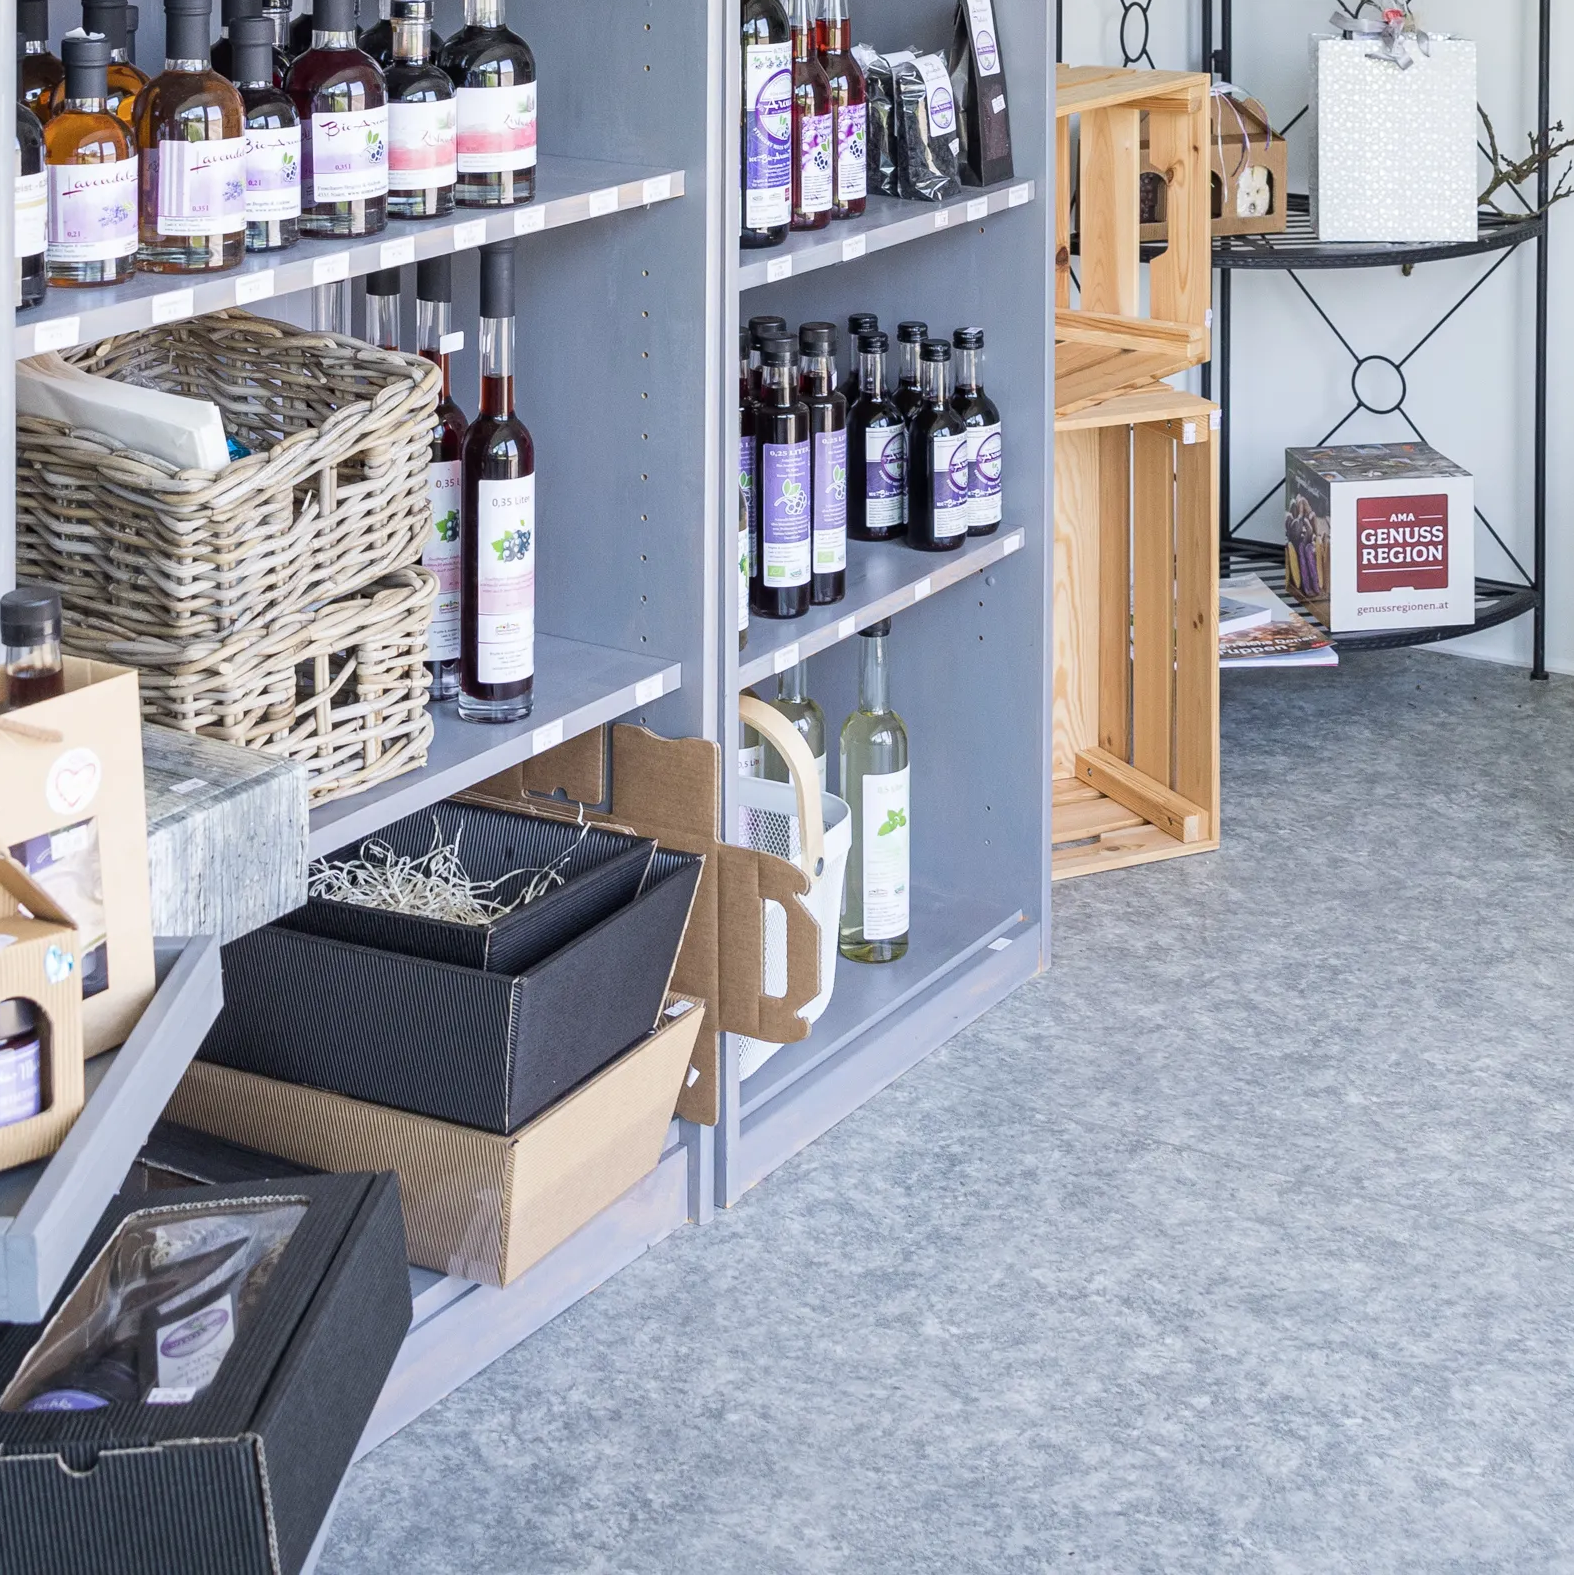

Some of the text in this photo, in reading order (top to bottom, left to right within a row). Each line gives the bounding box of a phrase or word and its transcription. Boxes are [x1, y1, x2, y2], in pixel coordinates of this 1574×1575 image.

[436, 479, 454, 489] 0,35
[492, 496, 530, 508] 0,35 Liter
[1390, 514, 1415, 522] AMA
[1361, 526, 1444, 545] GENUSS
[1362, 545, 1443, 565] REGION
[1357, 601, 1449, 616] genussregionen.at
